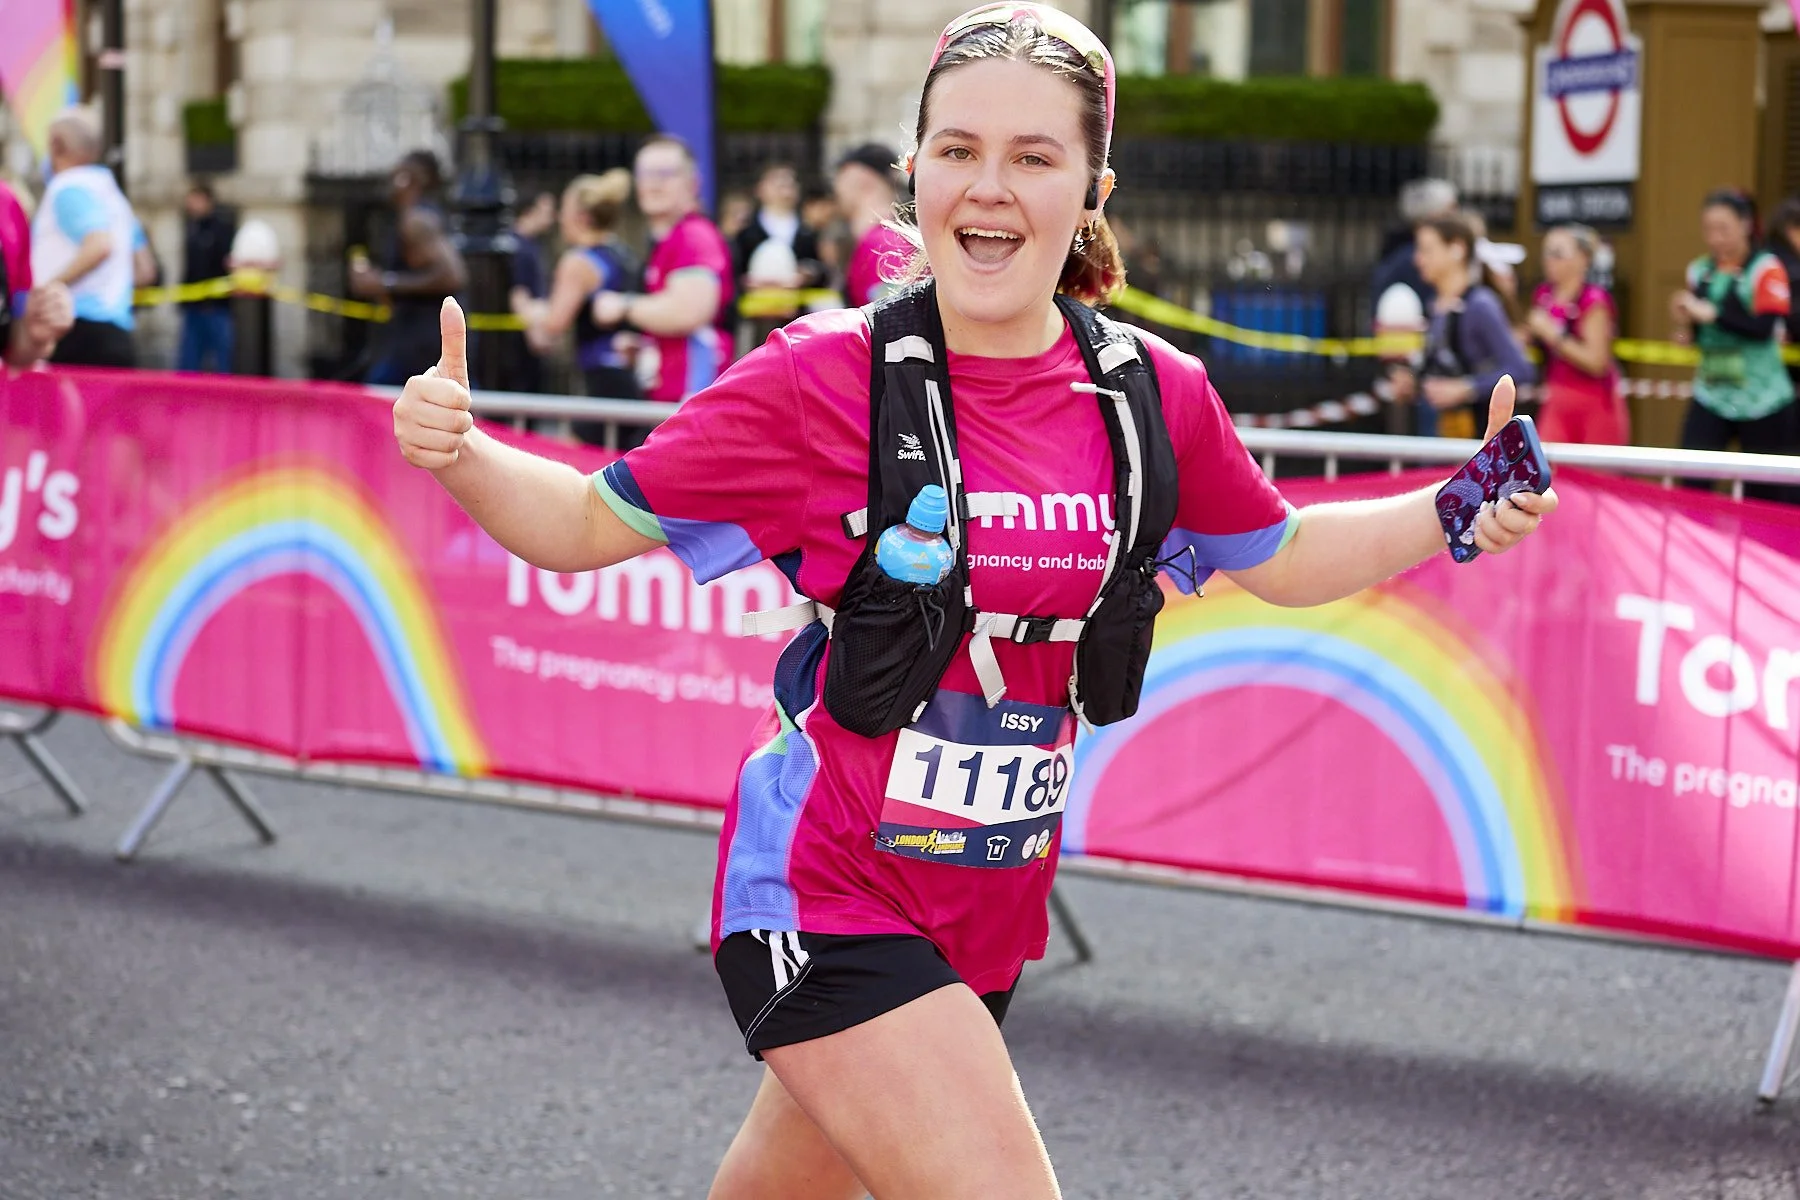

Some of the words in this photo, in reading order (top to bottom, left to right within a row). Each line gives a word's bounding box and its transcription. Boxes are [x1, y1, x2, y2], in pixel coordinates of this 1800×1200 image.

[1038, 552, 1072, 570] and
[1077, 553, 1108, 570] bab
[507, 550, 812, 642] omm
[491, 635, 536, 673] The
[678, 675, 735, 705] and
[1000, 712, 1043, 733] ISSY
[915, 744, 1068, 812] 11189
[1607, 743, 1667, 786] The
[1673, 763, 1800, 809] pregna
[895, 834, 929, 847] LONDON
